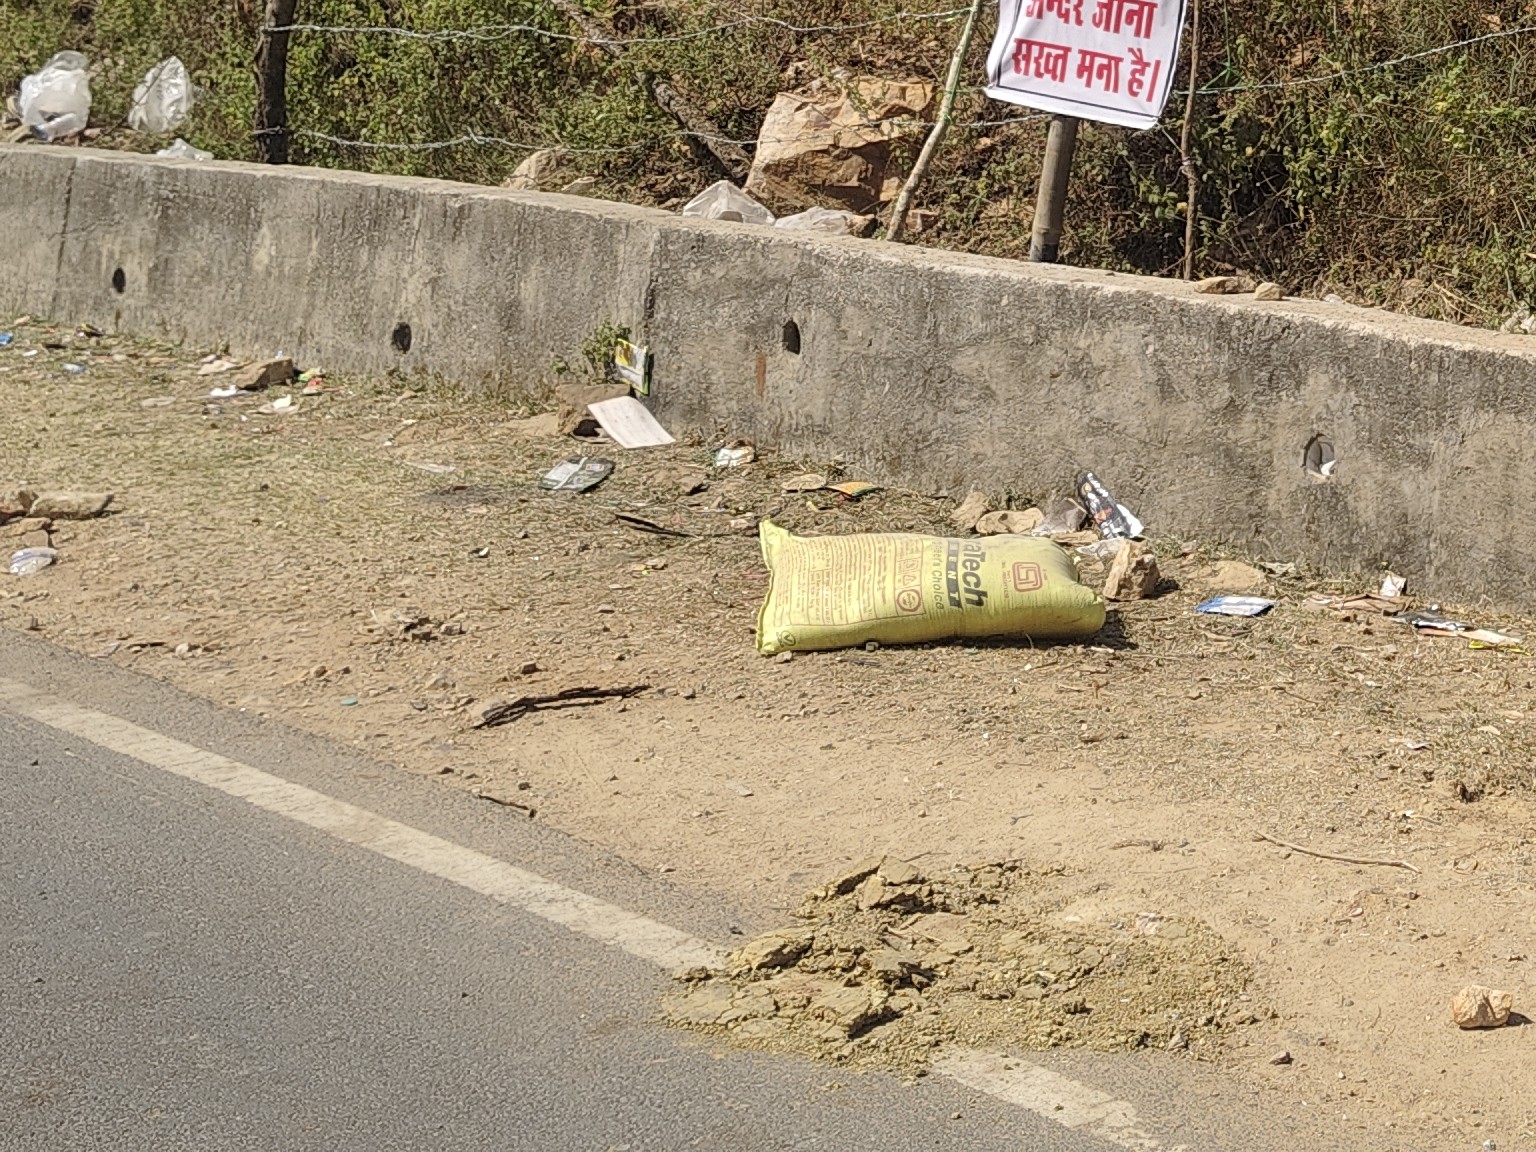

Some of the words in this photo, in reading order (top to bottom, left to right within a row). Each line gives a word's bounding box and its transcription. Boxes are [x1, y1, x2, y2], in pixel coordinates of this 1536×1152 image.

[1011, 38, 1072, 83] सख्त
[1076, 49, 1124, 93] मना
[1127, 47, 1162, 102] है।
[931, 569, 945, 611] Choice
